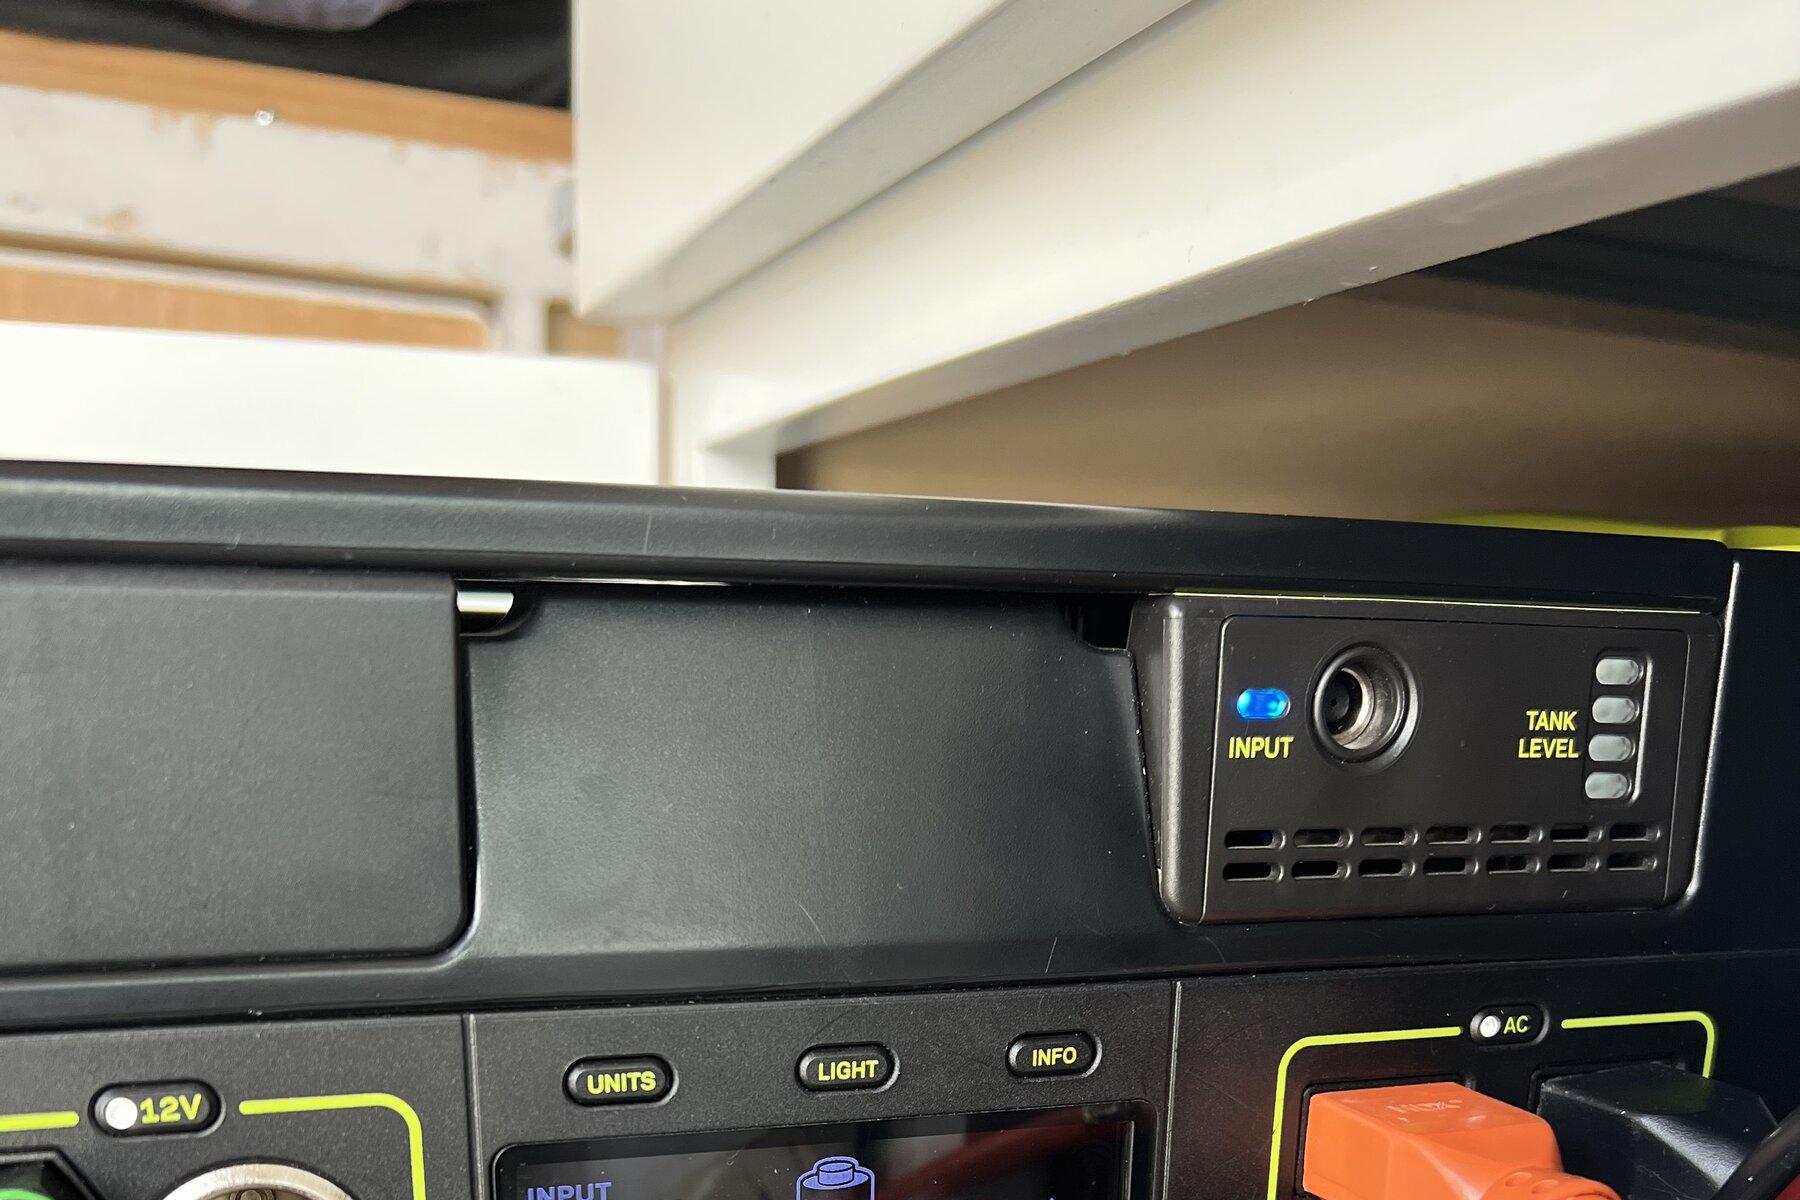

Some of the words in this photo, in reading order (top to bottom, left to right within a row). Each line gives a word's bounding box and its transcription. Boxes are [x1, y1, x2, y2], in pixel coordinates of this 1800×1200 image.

[1526, 710, 1577, 731] TANK
[1228, 735, 1292, 759] INPUT
[1519, 737, 1578, 759] LEVEL
[1503, 1013, 1532, 1035] AC
[1032, 1047, 1077, 1067] INFO
[819, 1059, 877, 1082] LIGHT
[586, 1071, 656, 1095] UNITS
[139, 1093, 202, 1124] 12V
